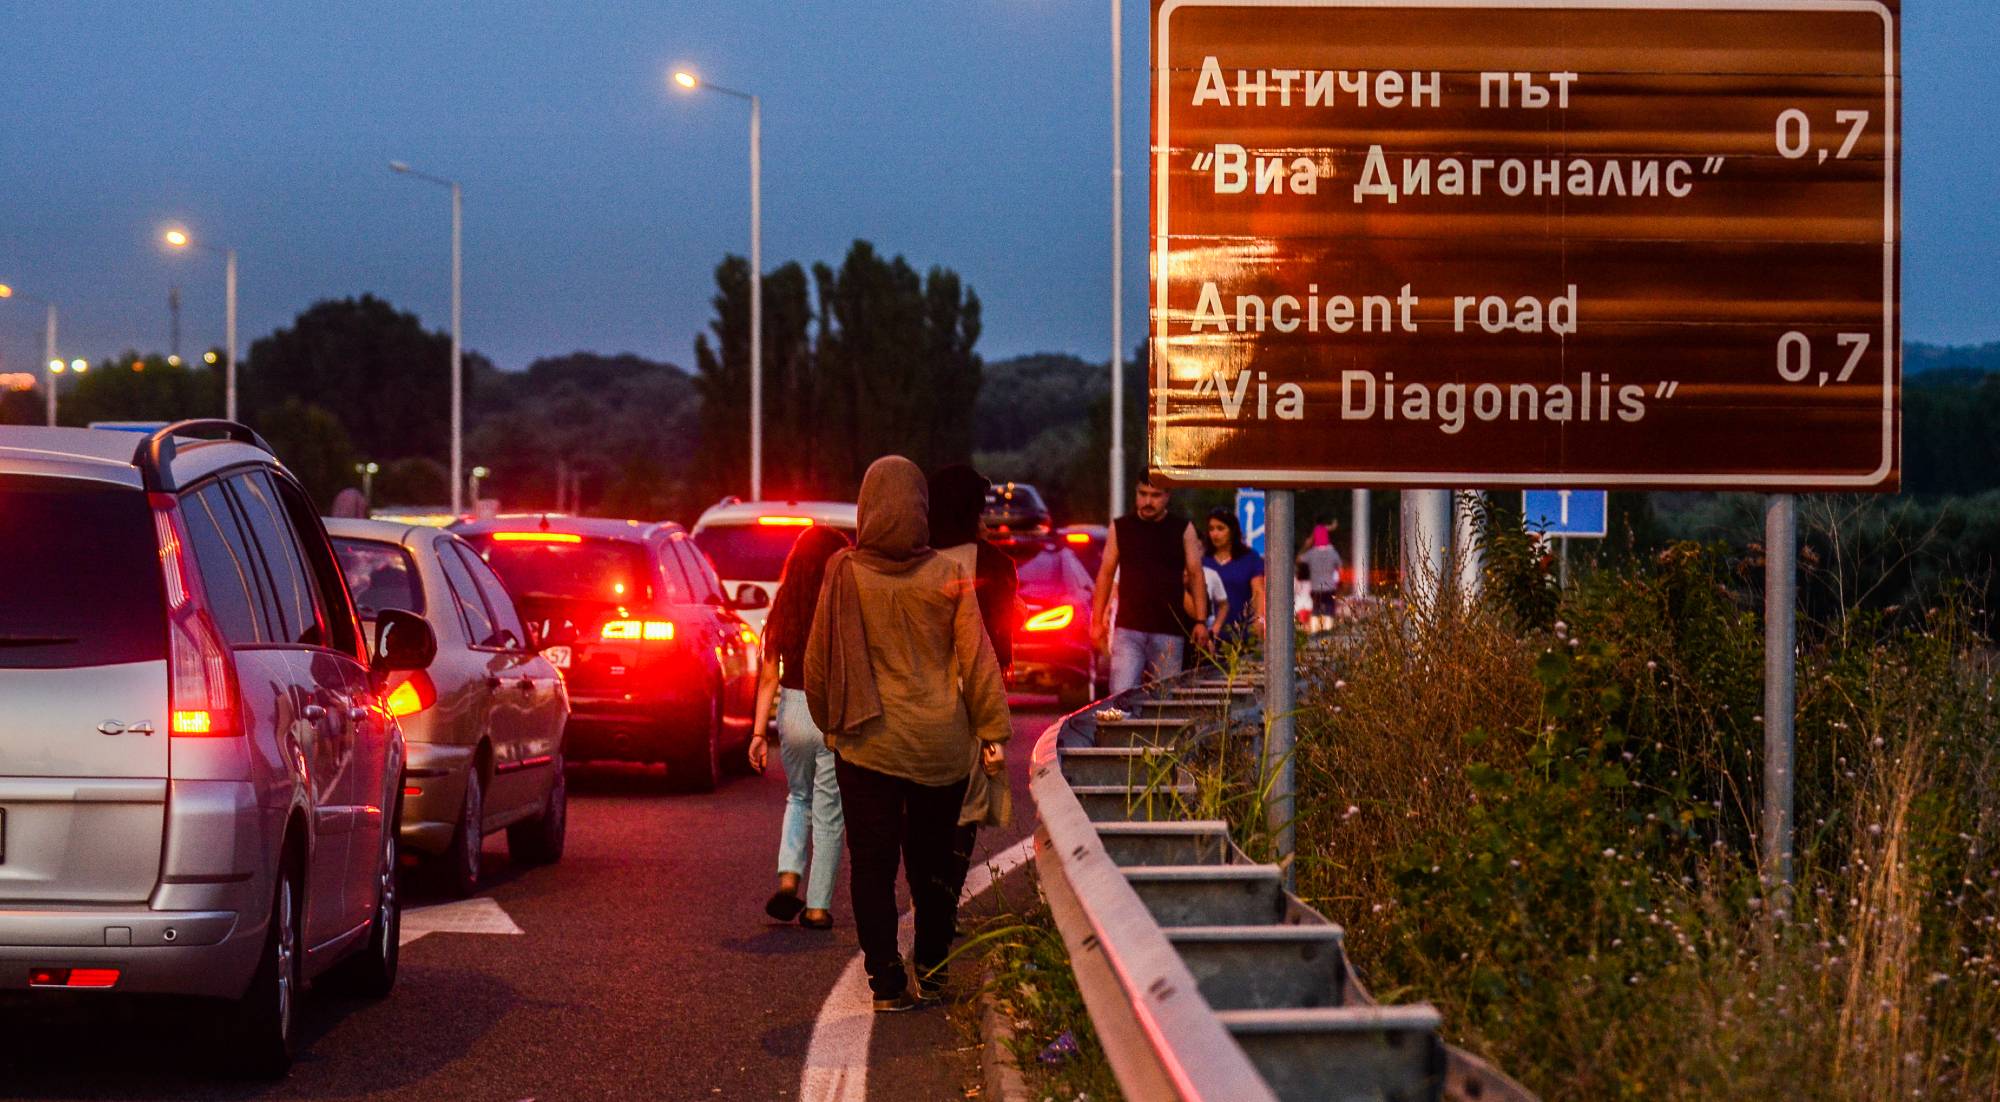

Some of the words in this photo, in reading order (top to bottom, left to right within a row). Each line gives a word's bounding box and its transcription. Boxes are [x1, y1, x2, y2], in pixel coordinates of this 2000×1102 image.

[1191, 56, 1440, 108] Античен
[1480, 71, 1578, 109] път
[1775, 108, 1869, 165] 0,7
[1190, 281, 1418, 333] Ancient
[1454, 284, 1577, 334] road
[1776, 331, 1870, 387] 0,7
[97, 719, 155, 736] C4
